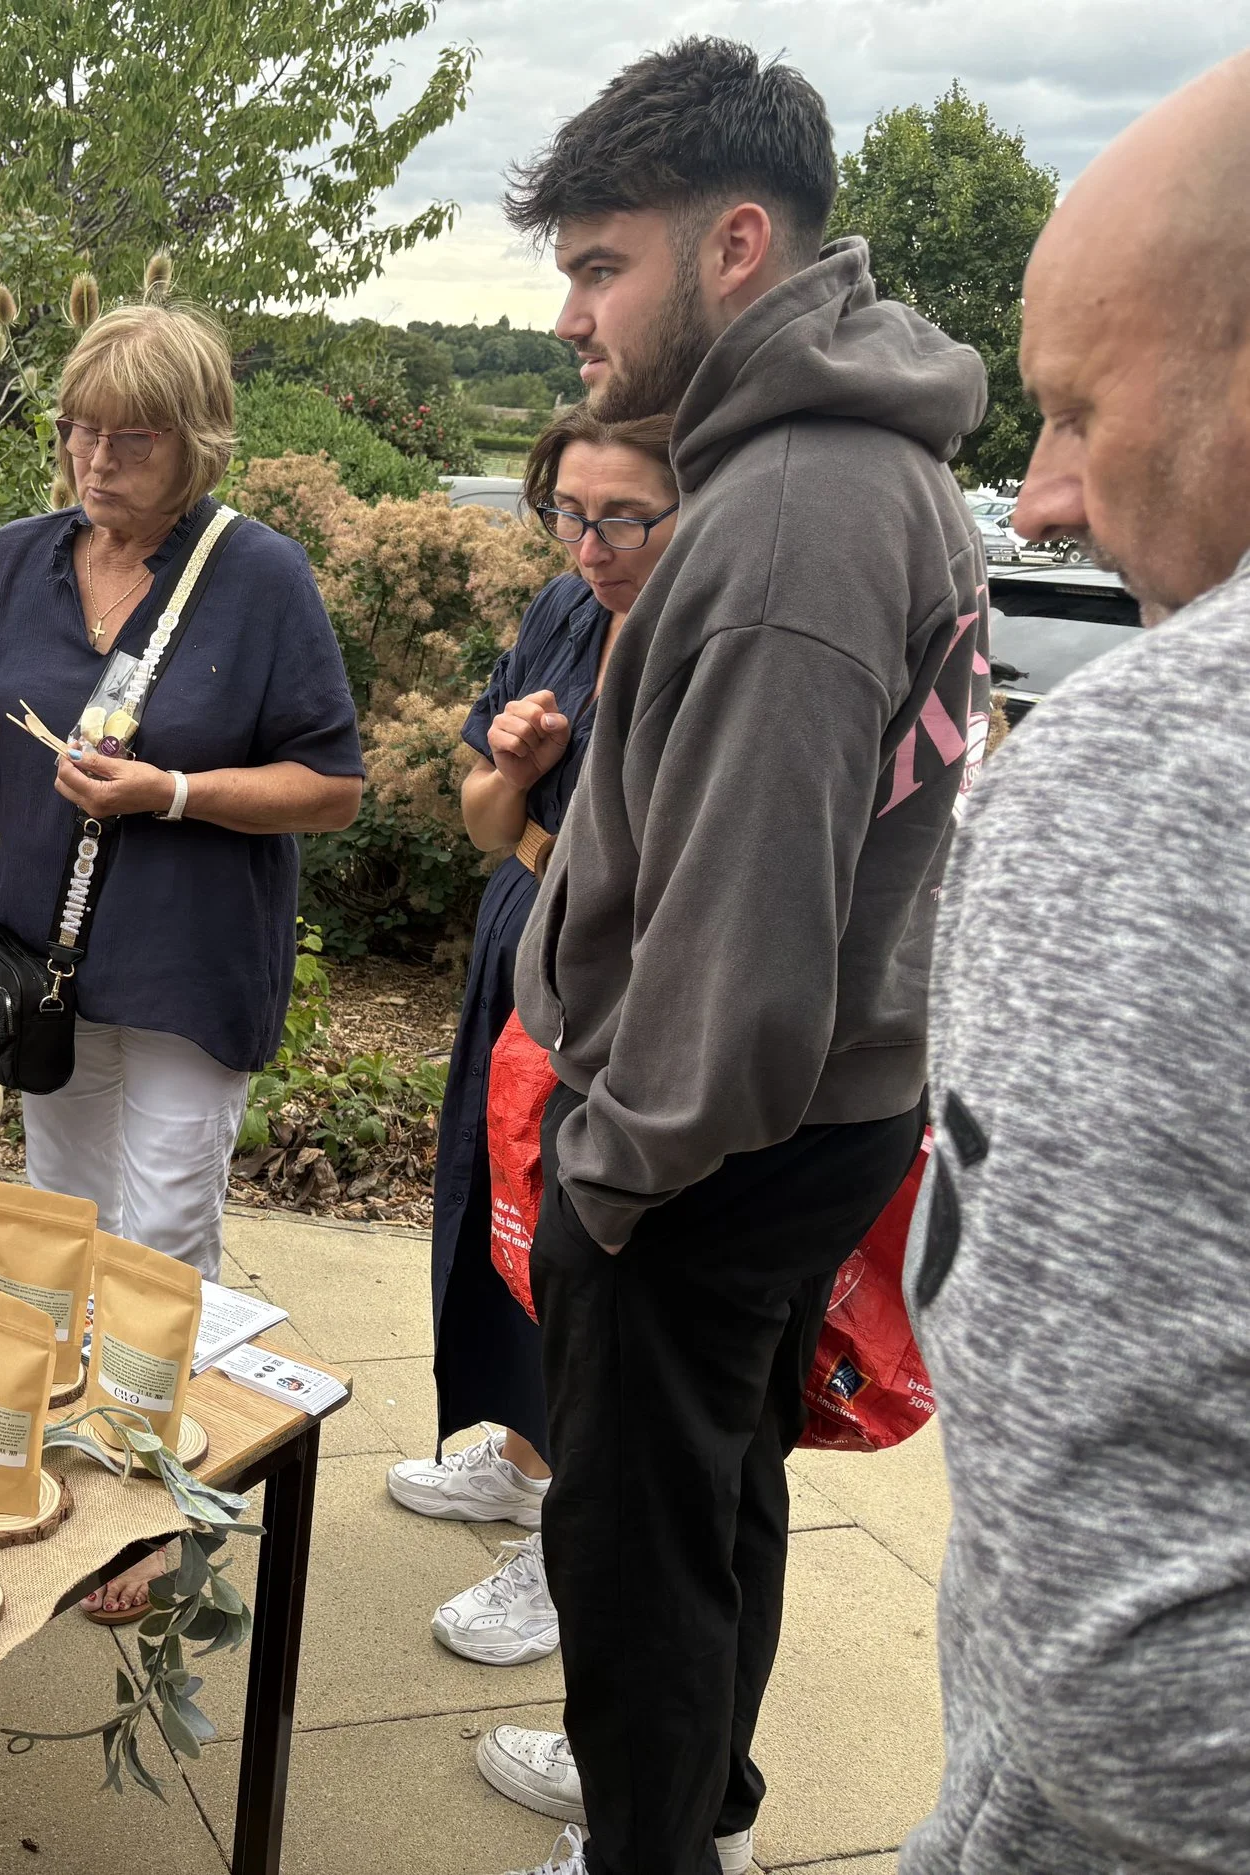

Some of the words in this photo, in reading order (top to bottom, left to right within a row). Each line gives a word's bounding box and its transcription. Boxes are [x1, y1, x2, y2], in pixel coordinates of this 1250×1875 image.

[492, 1210, 505, 1226] his
[506, 1217, 522, 1234] bag
[114, 1387, 140, 1404] CWO
[907, 1378, 936, 1398] beca
[908, 1396, 936, 1414] 50%
